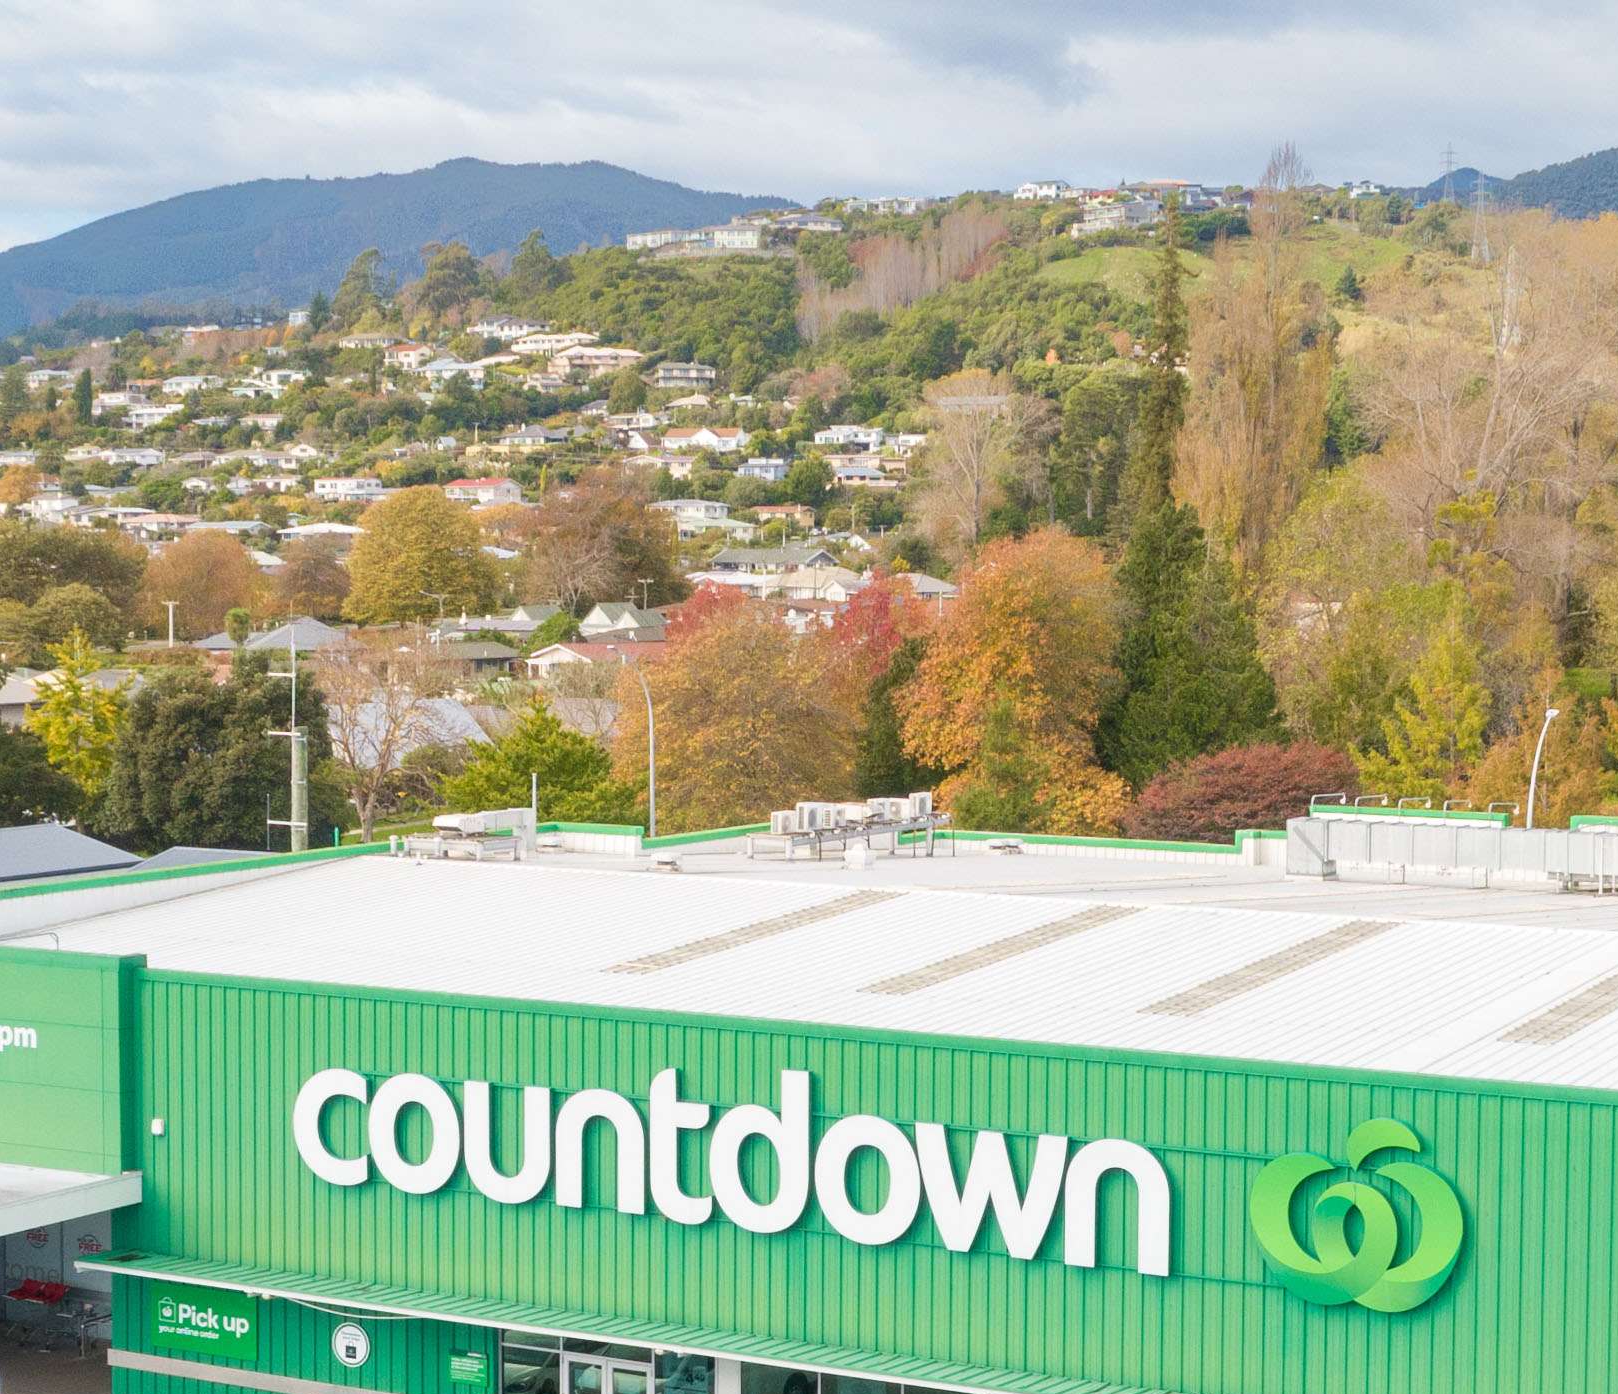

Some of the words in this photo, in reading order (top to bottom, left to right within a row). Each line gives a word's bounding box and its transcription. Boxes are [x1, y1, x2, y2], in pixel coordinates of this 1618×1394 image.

[293, 1067, 1170, 1277] countdown
[159, 1325, 175, 1334] your
[178, 1303, 219, 1329] Pick
[223, 1315, 249, 1338] up
